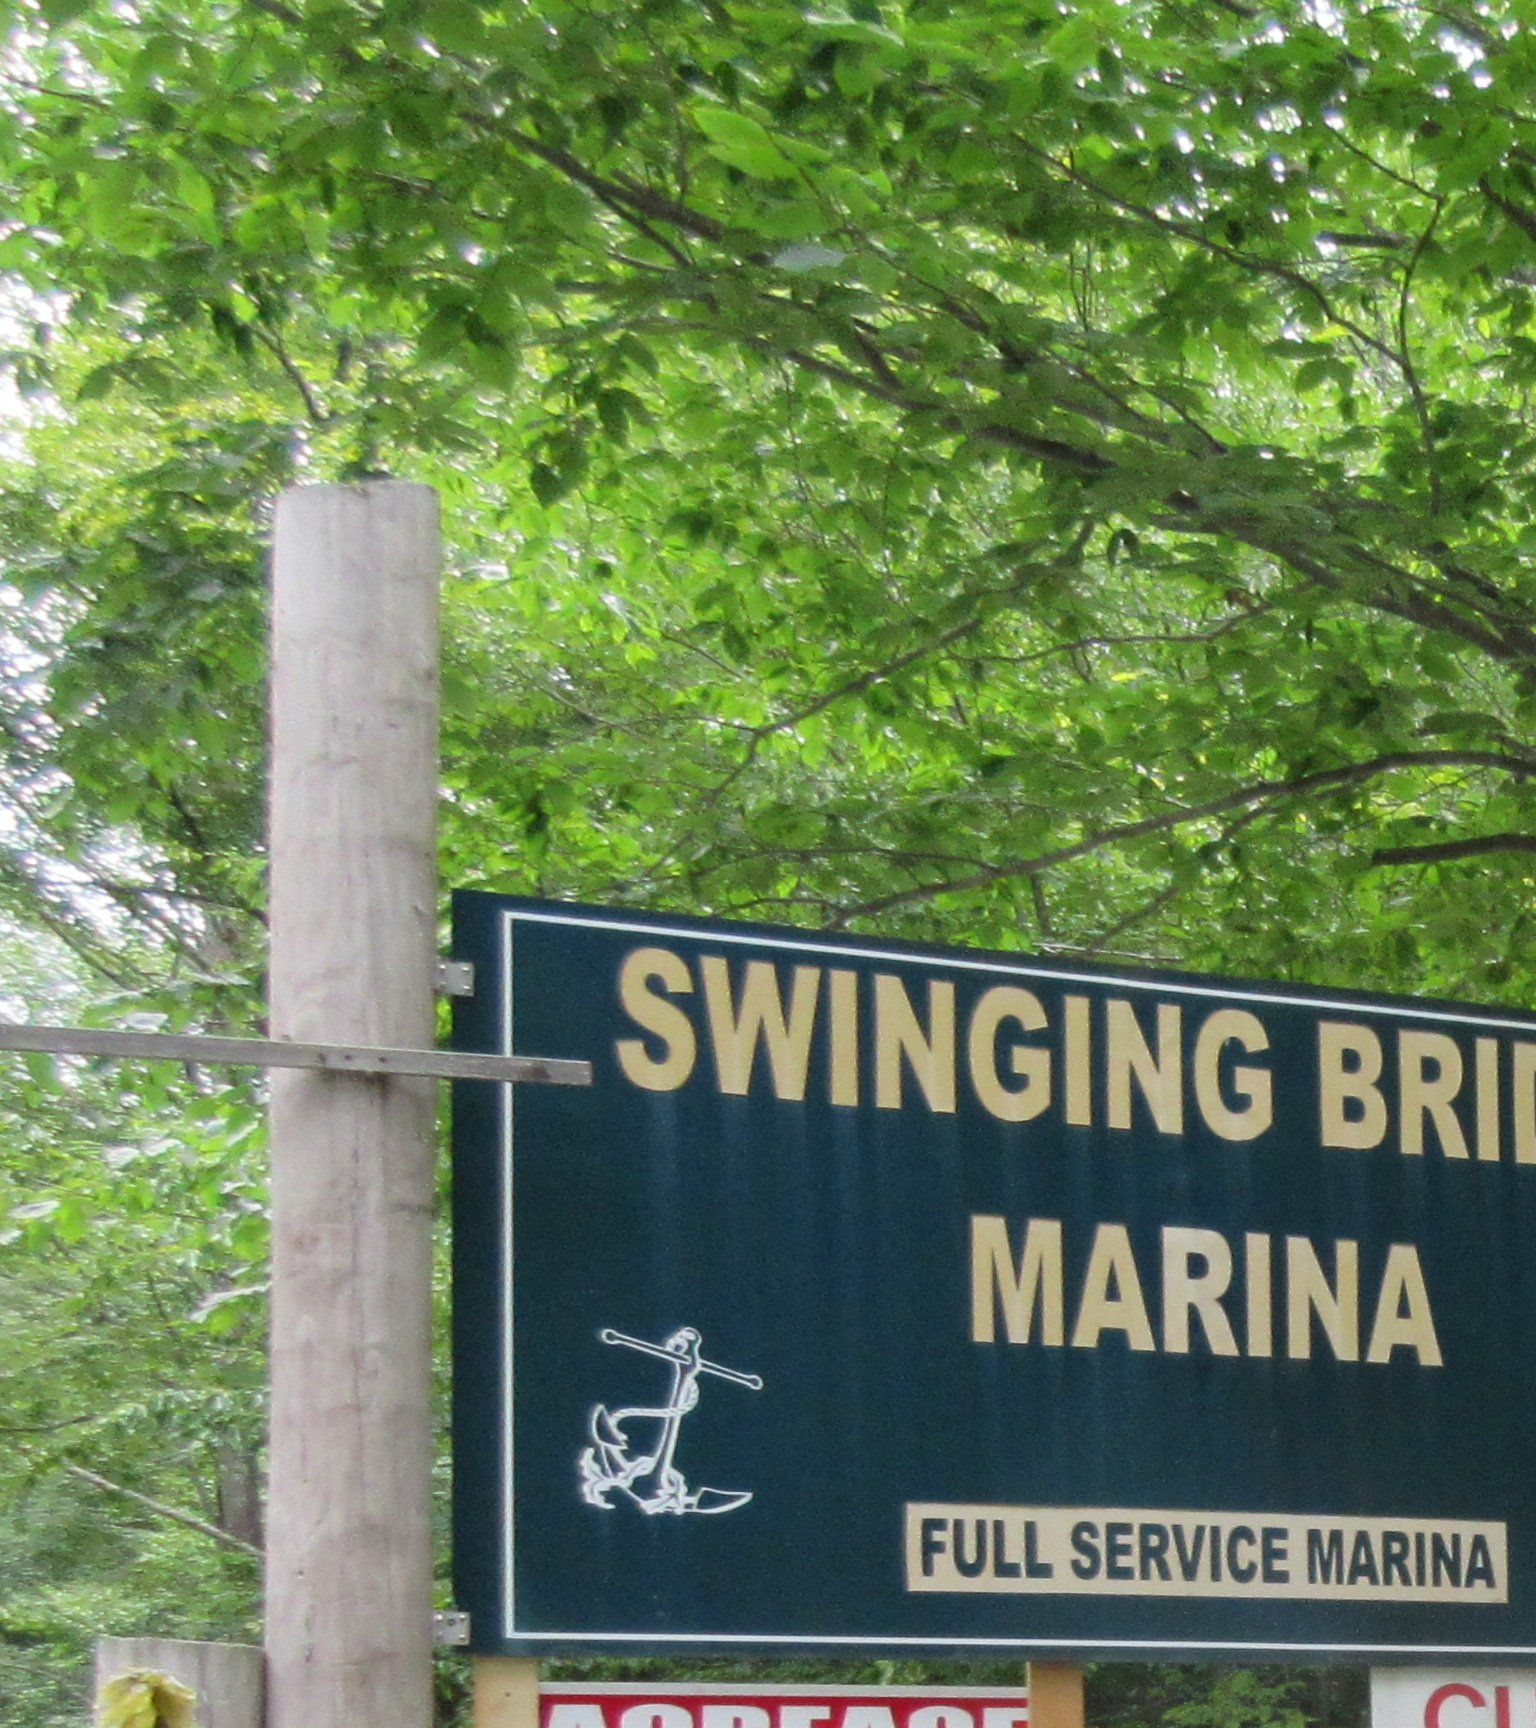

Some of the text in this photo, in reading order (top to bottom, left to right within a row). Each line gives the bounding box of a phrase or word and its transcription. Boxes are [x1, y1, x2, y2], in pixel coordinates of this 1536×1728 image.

[616, 948, 1272, 1141] SWINGING
[970, 1214, 1443, 1366] MARINA
[920, 1517, 1497, 1588] FULL SERVICE MARINA
